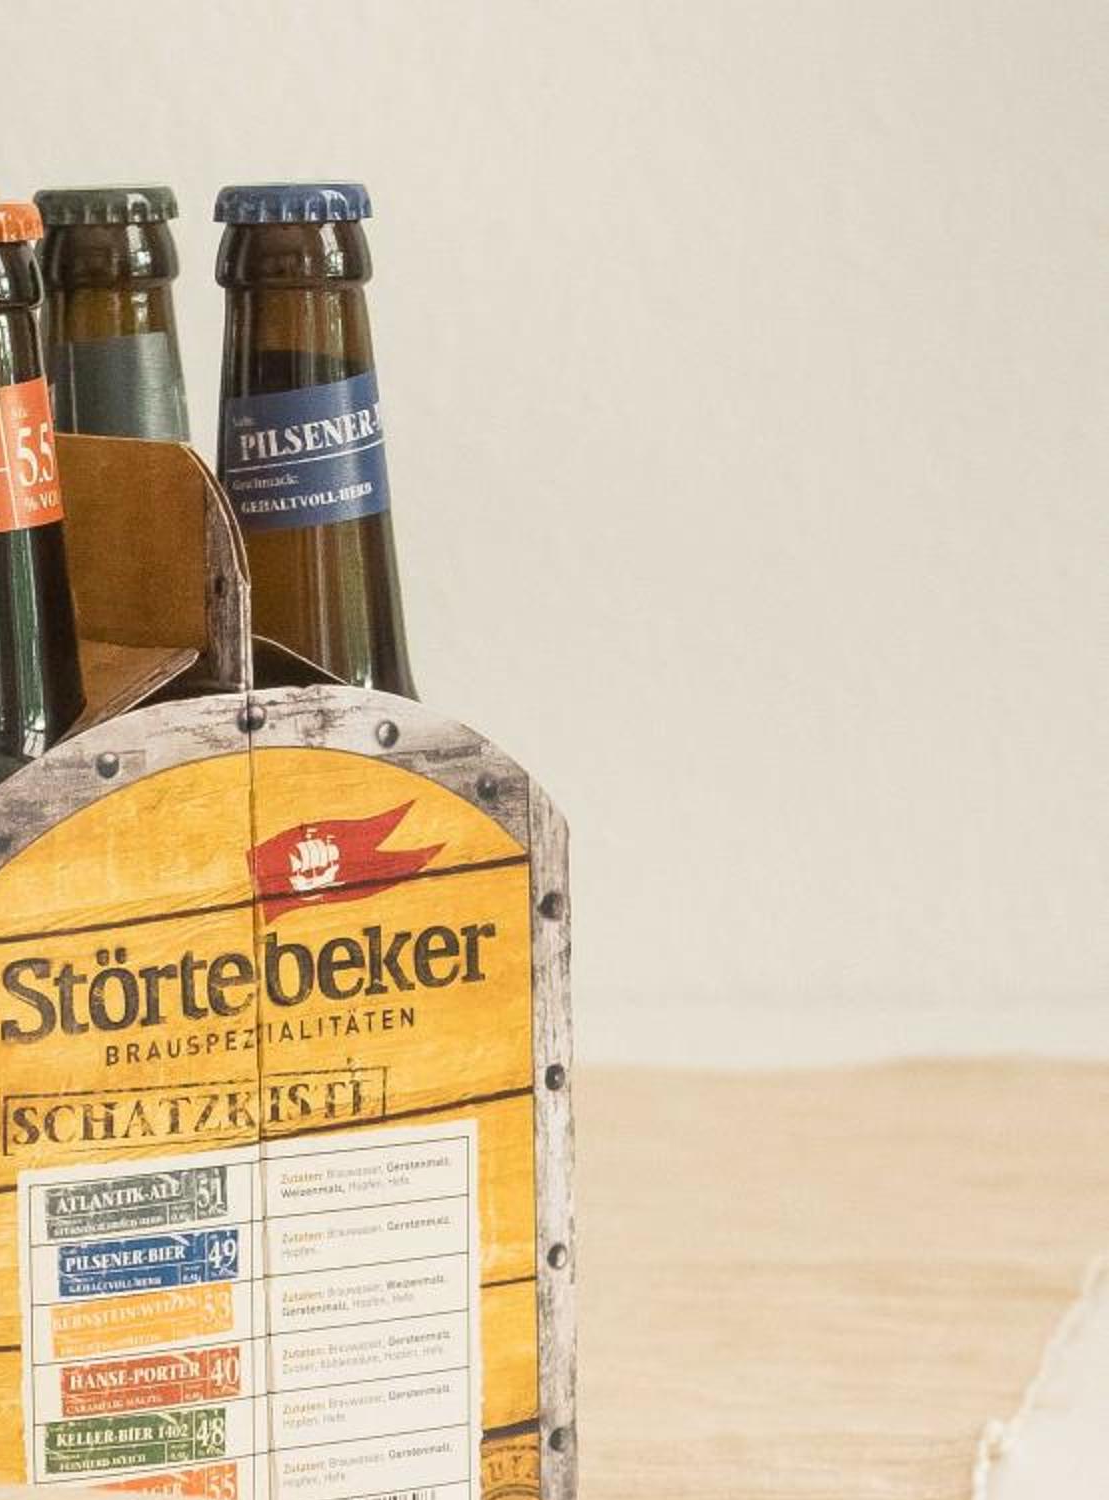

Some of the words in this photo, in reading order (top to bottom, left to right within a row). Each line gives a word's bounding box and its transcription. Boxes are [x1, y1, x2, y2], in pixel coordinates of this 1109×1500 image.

[0, 922, 497, 1045] Störtebeker
[104, 1005, 417, 1067] BRAUSPEZIALITÄTEN
[10, 1078, 379, 1146] SCHATZKISTE
[55, 1176, 184, 1215] ATLANTIK-ALE
[65, 1245, 187, 1274] PILSENER-BIER
[69, 1360, 201, 1391] HANSE-PORTER
[56, 1426, 154, 1448] KELLER-BIER
